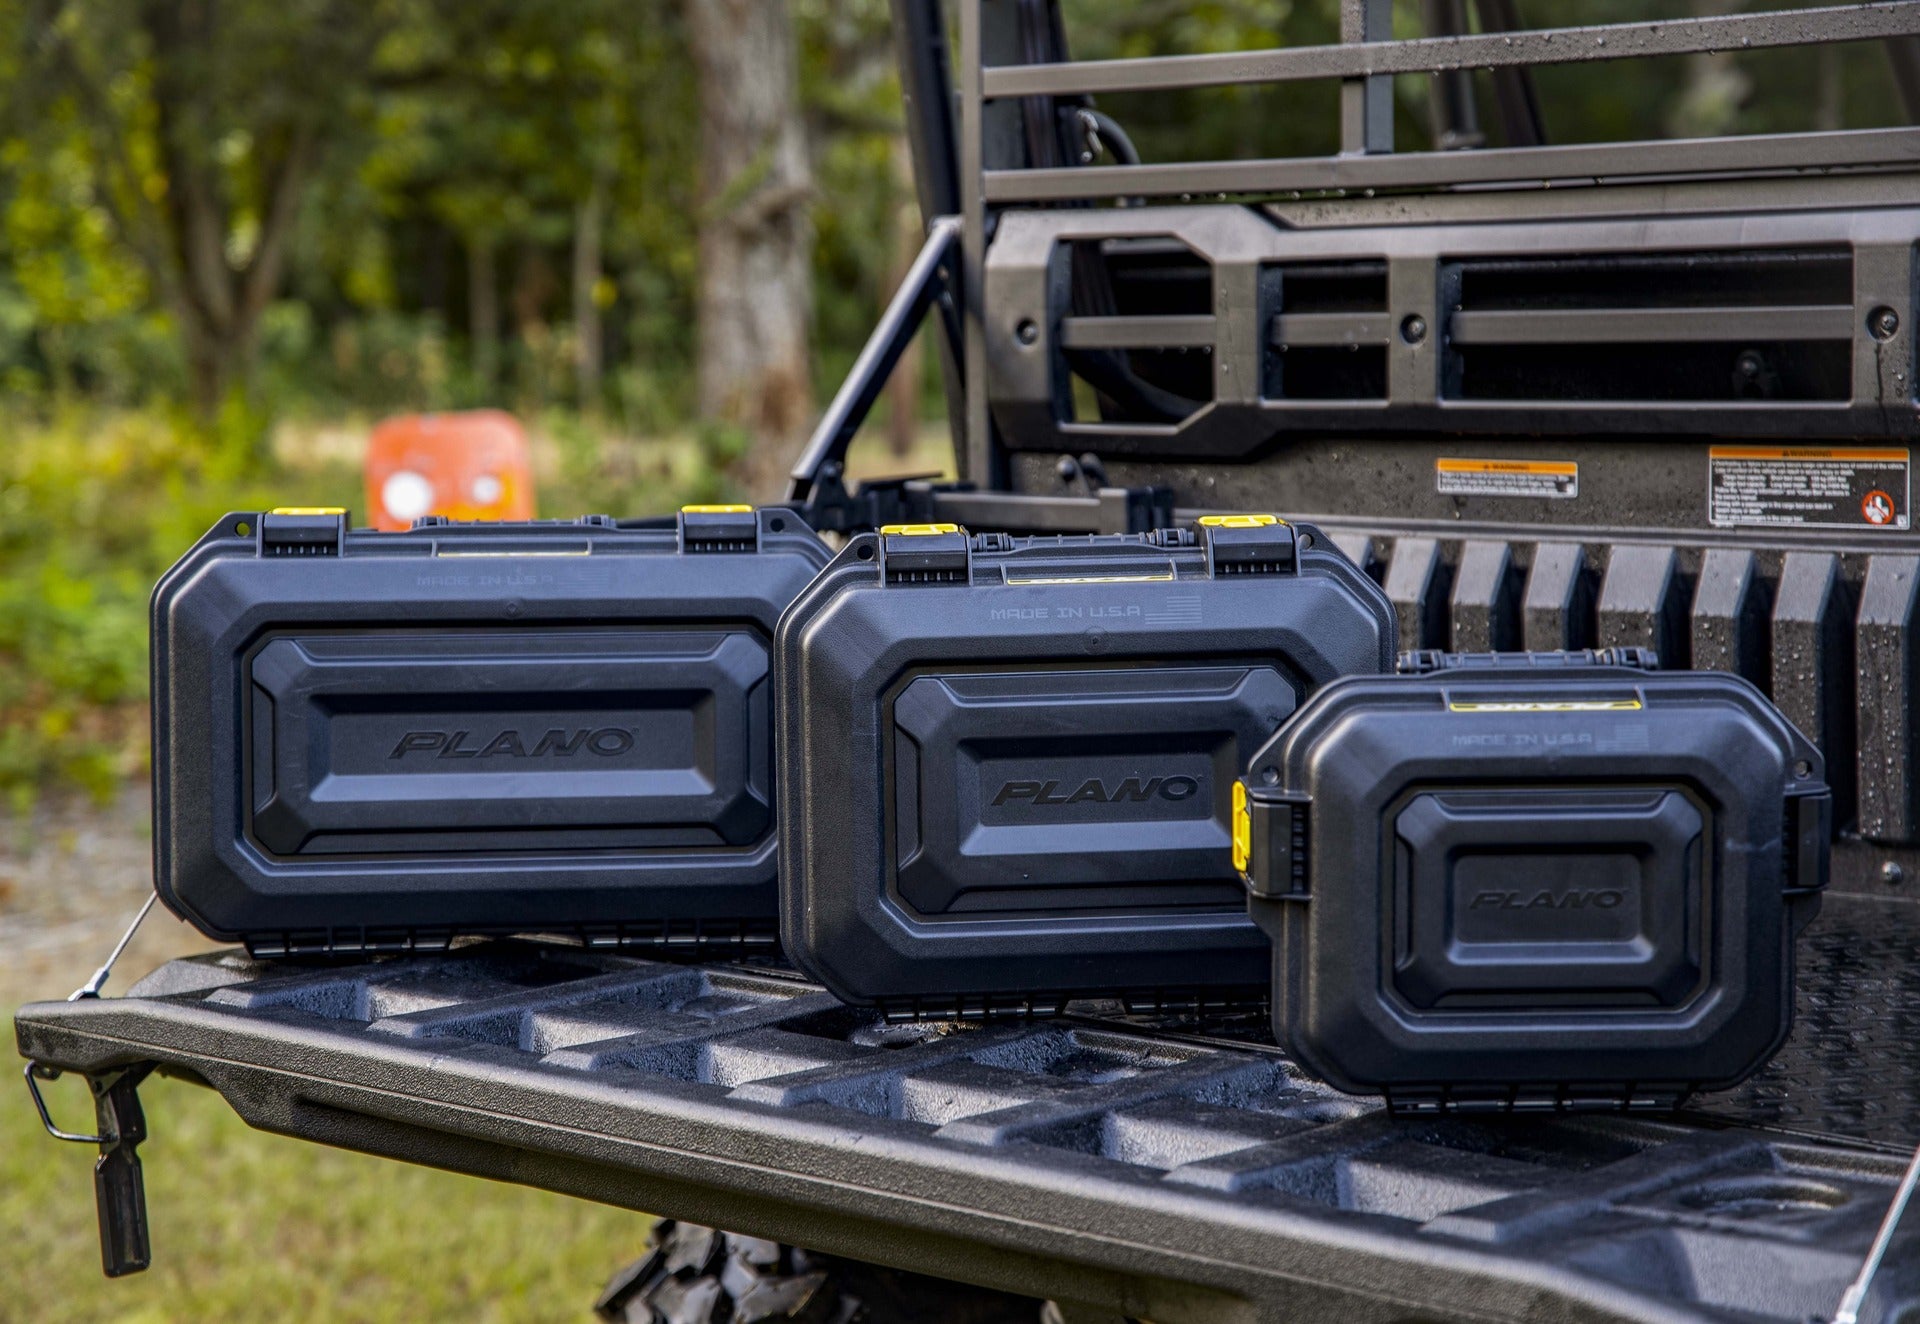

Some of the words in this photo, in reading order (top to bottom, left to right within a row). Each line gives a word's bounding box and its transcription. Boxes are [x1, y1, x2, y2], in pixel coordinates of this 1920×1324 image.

[990, 607, 1049, 620] MADE
[1056, 606, 1084, 619] IN
[388, 728, 635, 759] PLANO
[1453, 734, 1506, 746] MADE
[1514, 734, 1538, 745] IN
[991, 774, 1199, 806] PLANO
[1470, 889, 1624, 910] PLANO
